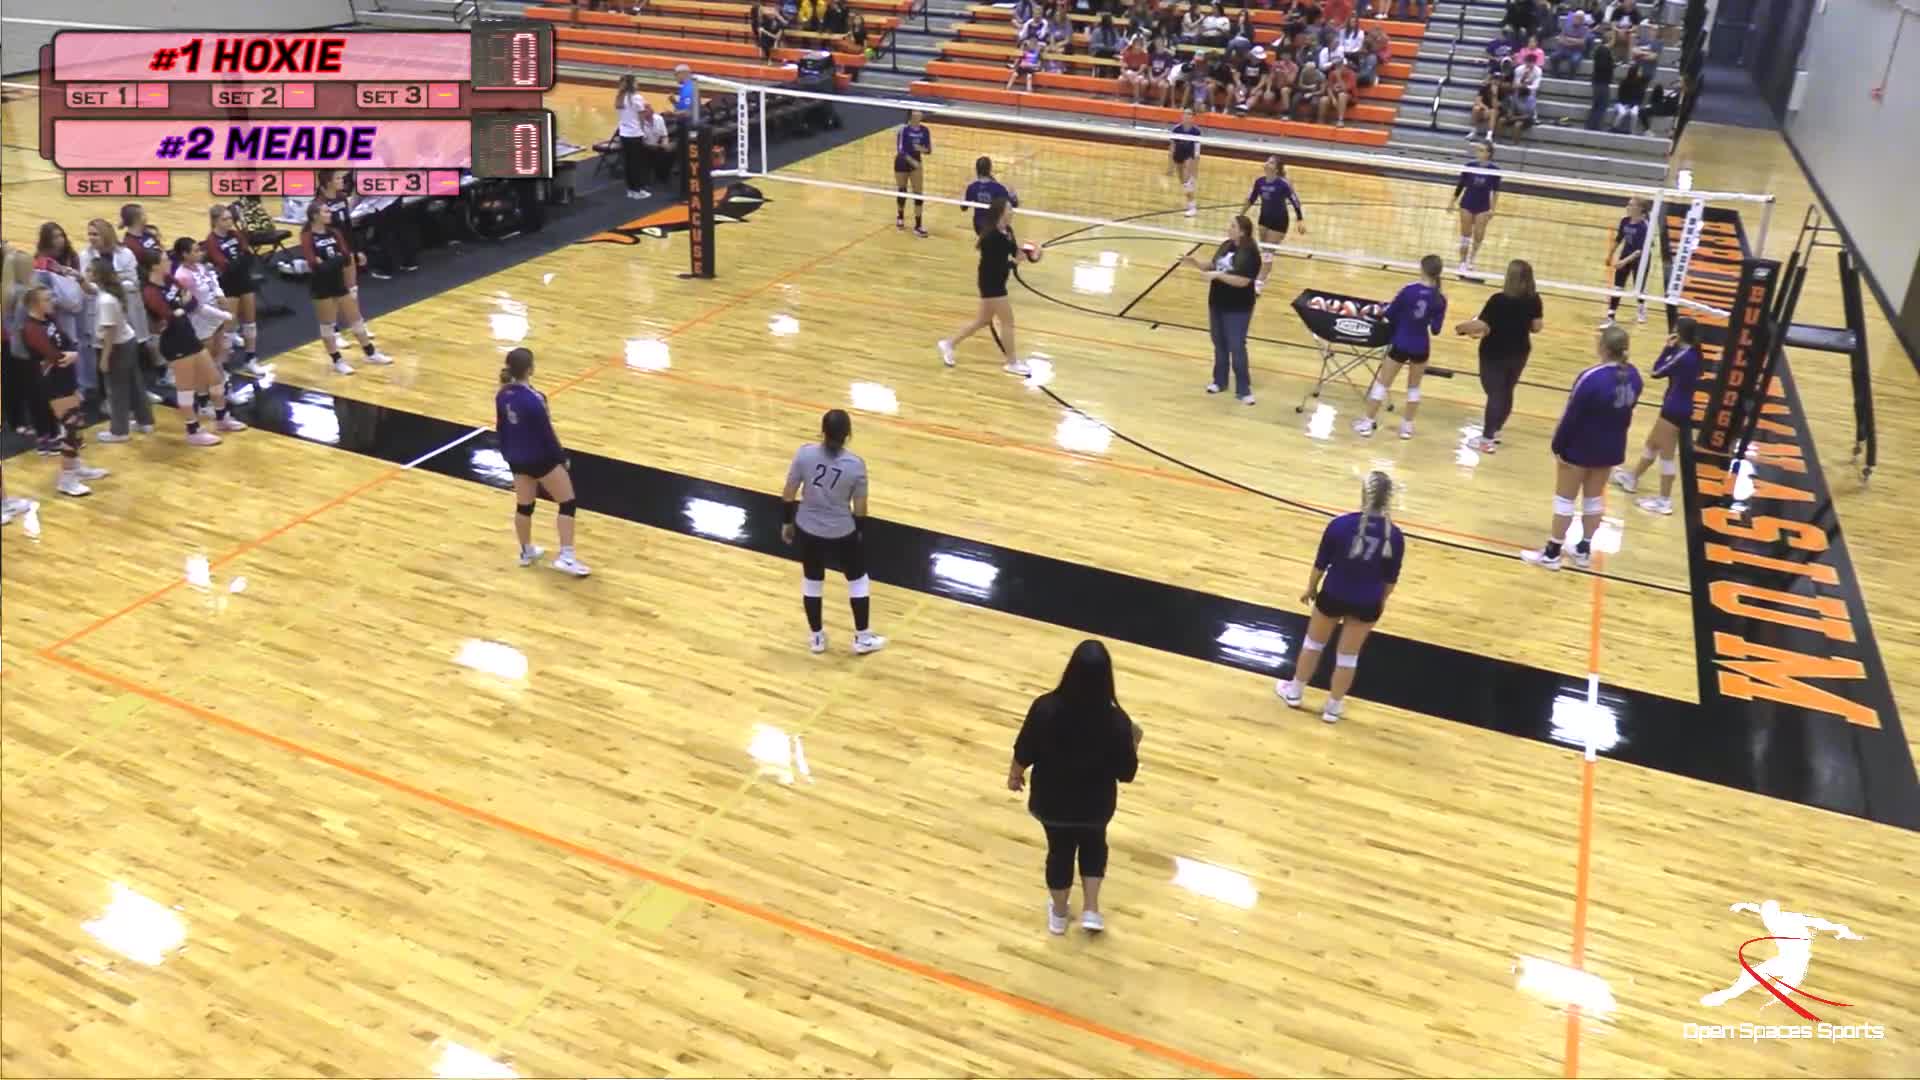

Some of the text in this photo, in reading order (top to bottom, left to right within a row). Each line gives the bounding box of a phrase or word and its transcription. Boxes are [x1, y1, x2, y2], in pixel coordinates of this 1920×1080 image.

[688, 143, 703, 274] SYRACUSE
[1709, 284, 1767, 448] BULLDOGS
[812, 463, 843, 490] 27
